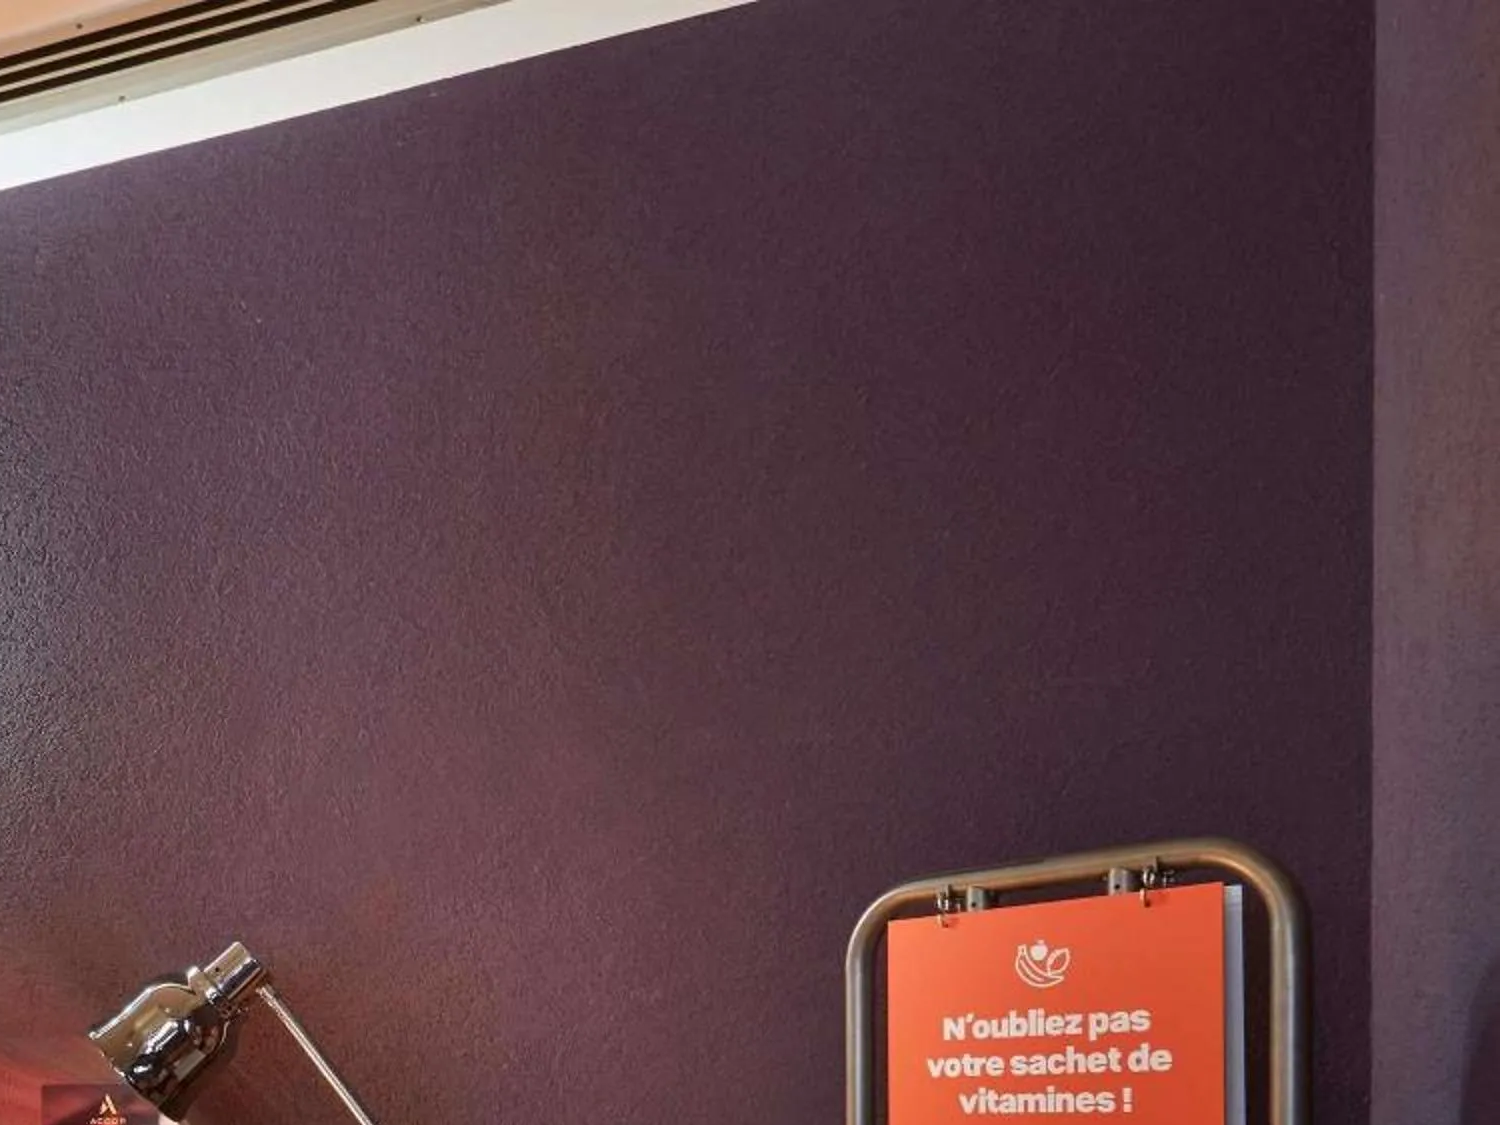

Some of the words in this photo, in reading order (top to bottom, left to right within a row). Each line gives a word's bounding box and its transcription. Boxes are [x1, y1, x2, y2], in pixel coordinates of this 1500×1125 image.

[942, 1007, 1084, 1042] N'oubliez
[1088, 1008, 1152, 1042] pas
[926, 1052, 1006, 1079] votre
[1010, 1045, 1123, 1077] sachet
[1127, 1042, 1174, 1074] de
[958, 1085, 1117, 1115] vitamines
[1122, 1087, 1134, 1114] !
